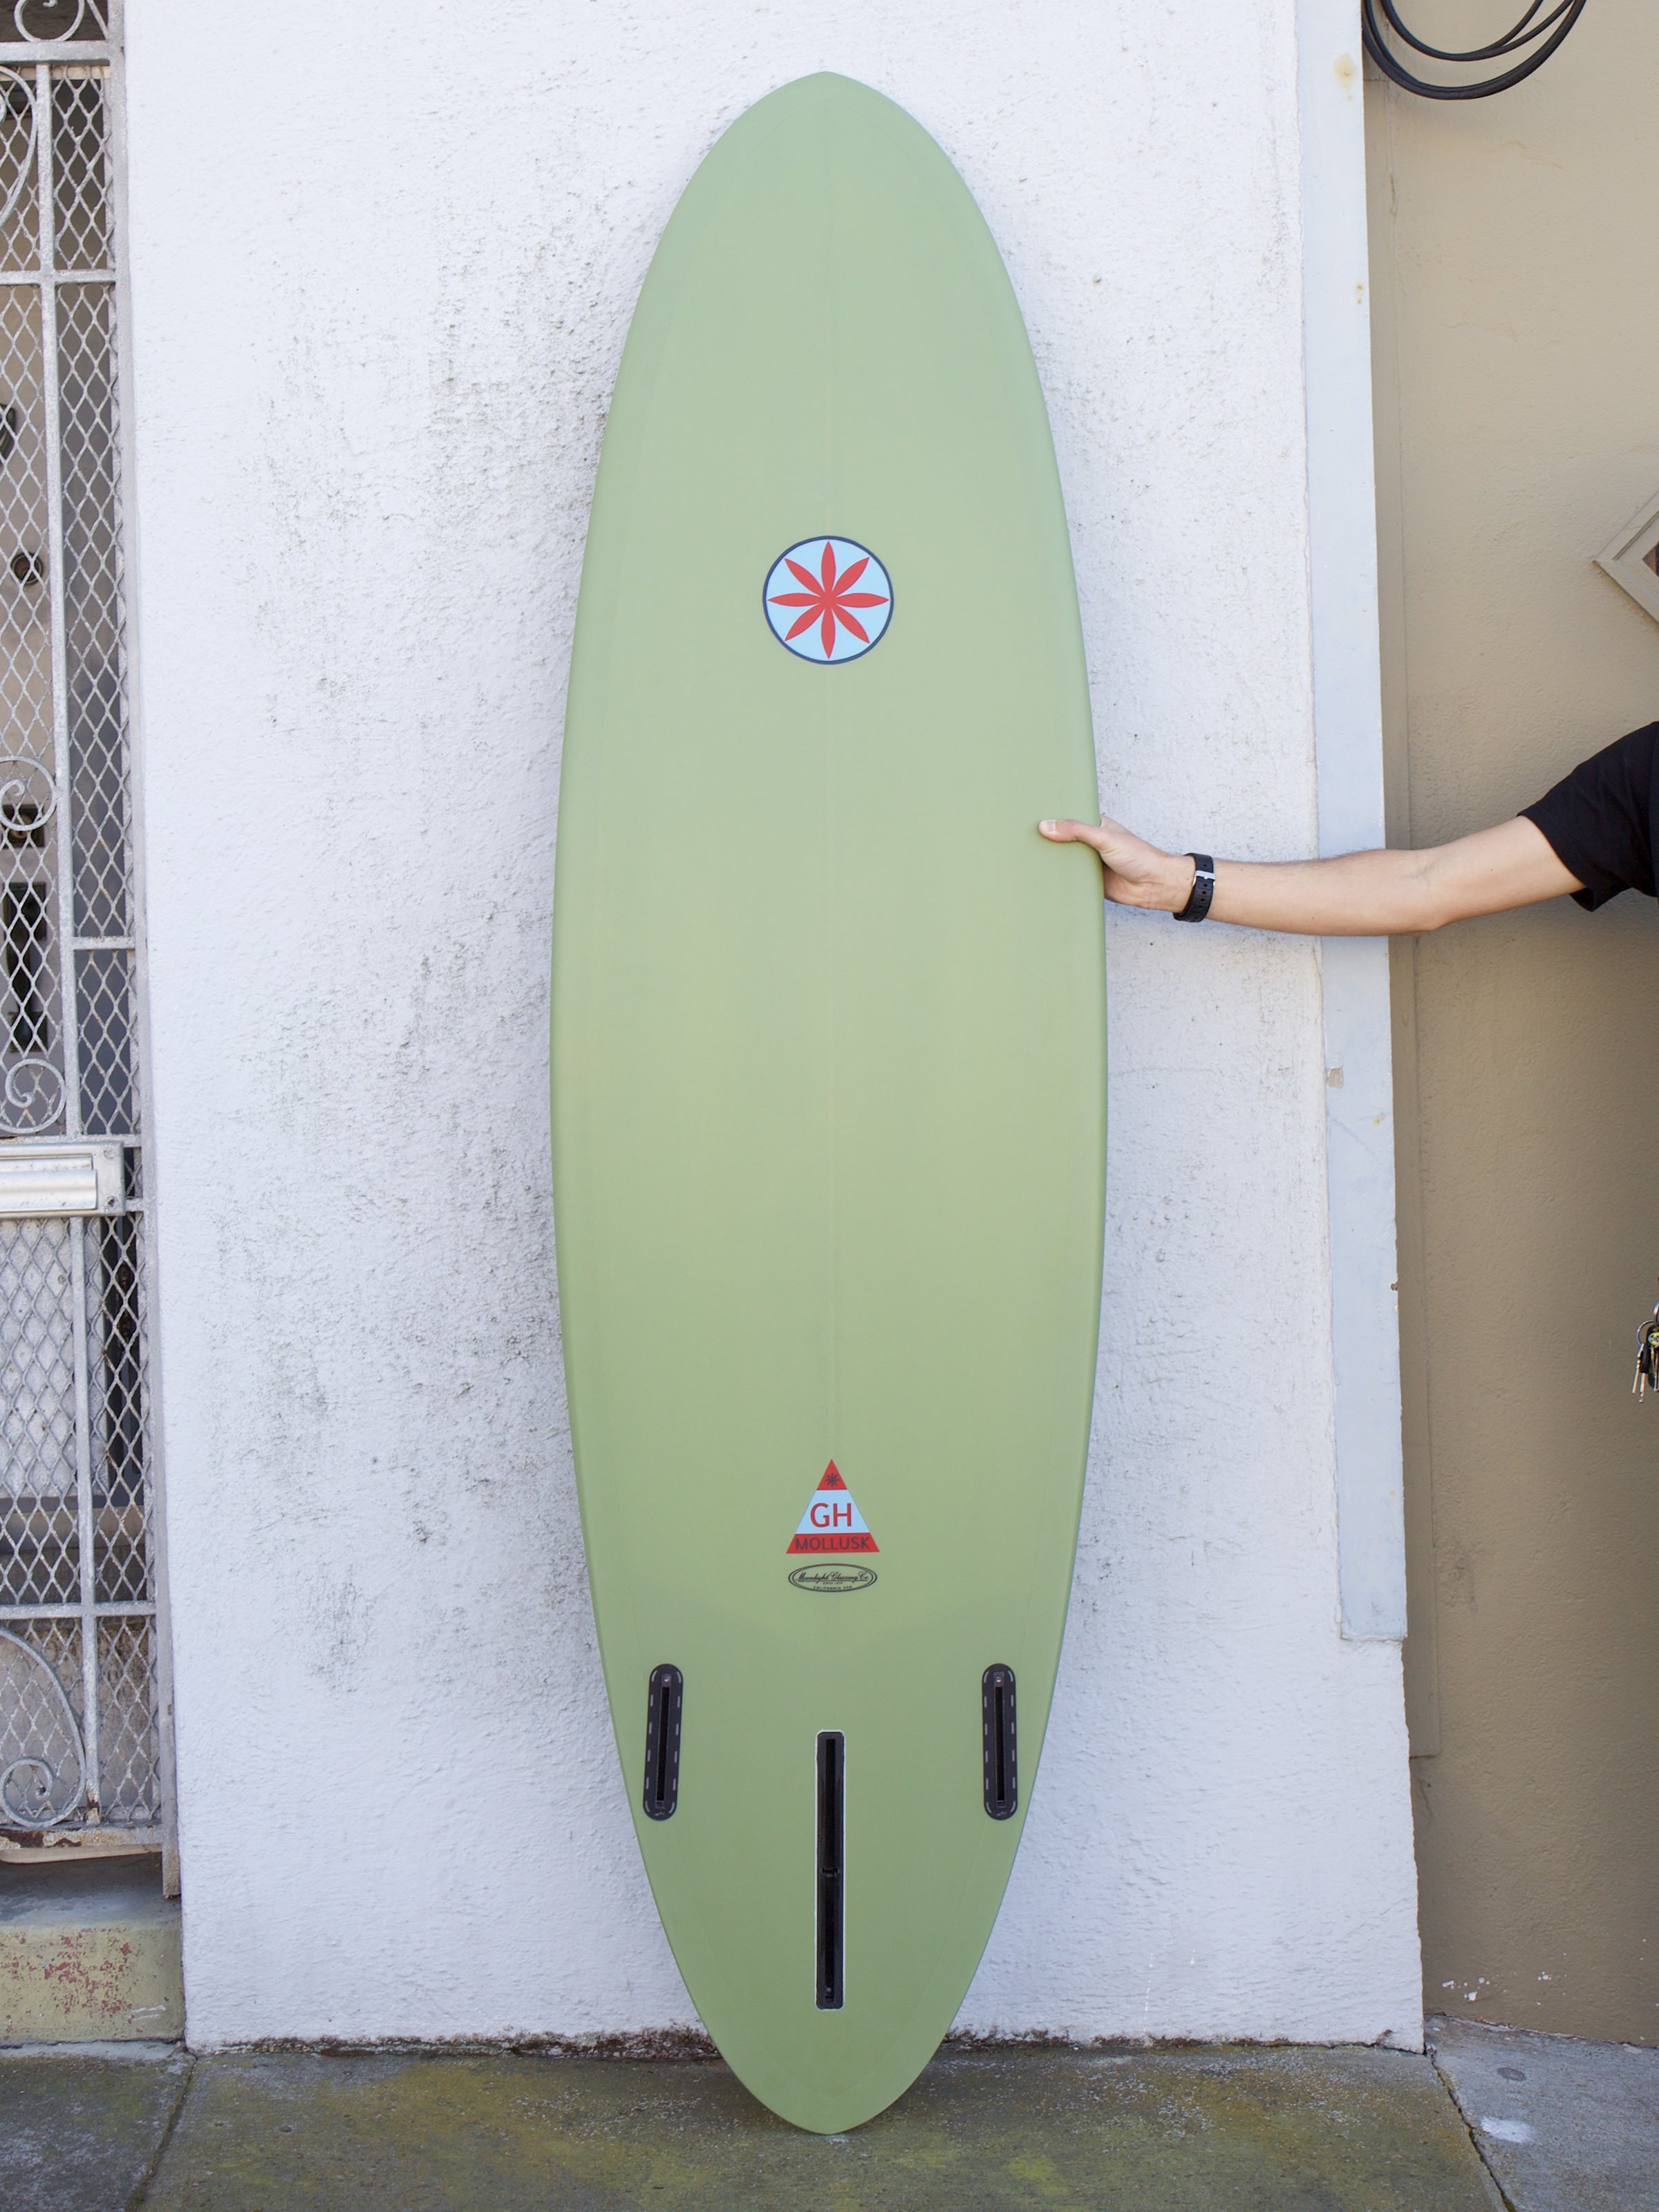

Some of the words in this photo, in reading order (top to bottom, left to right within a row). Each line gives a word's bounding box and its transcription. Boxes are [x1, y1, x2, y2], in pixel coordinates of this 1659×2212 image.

[810, 1503, 852, 1528] GH
[795, 1536, 870, 1550] MOLLUSK
[796, 1572, 830, 1584] Moonlight
